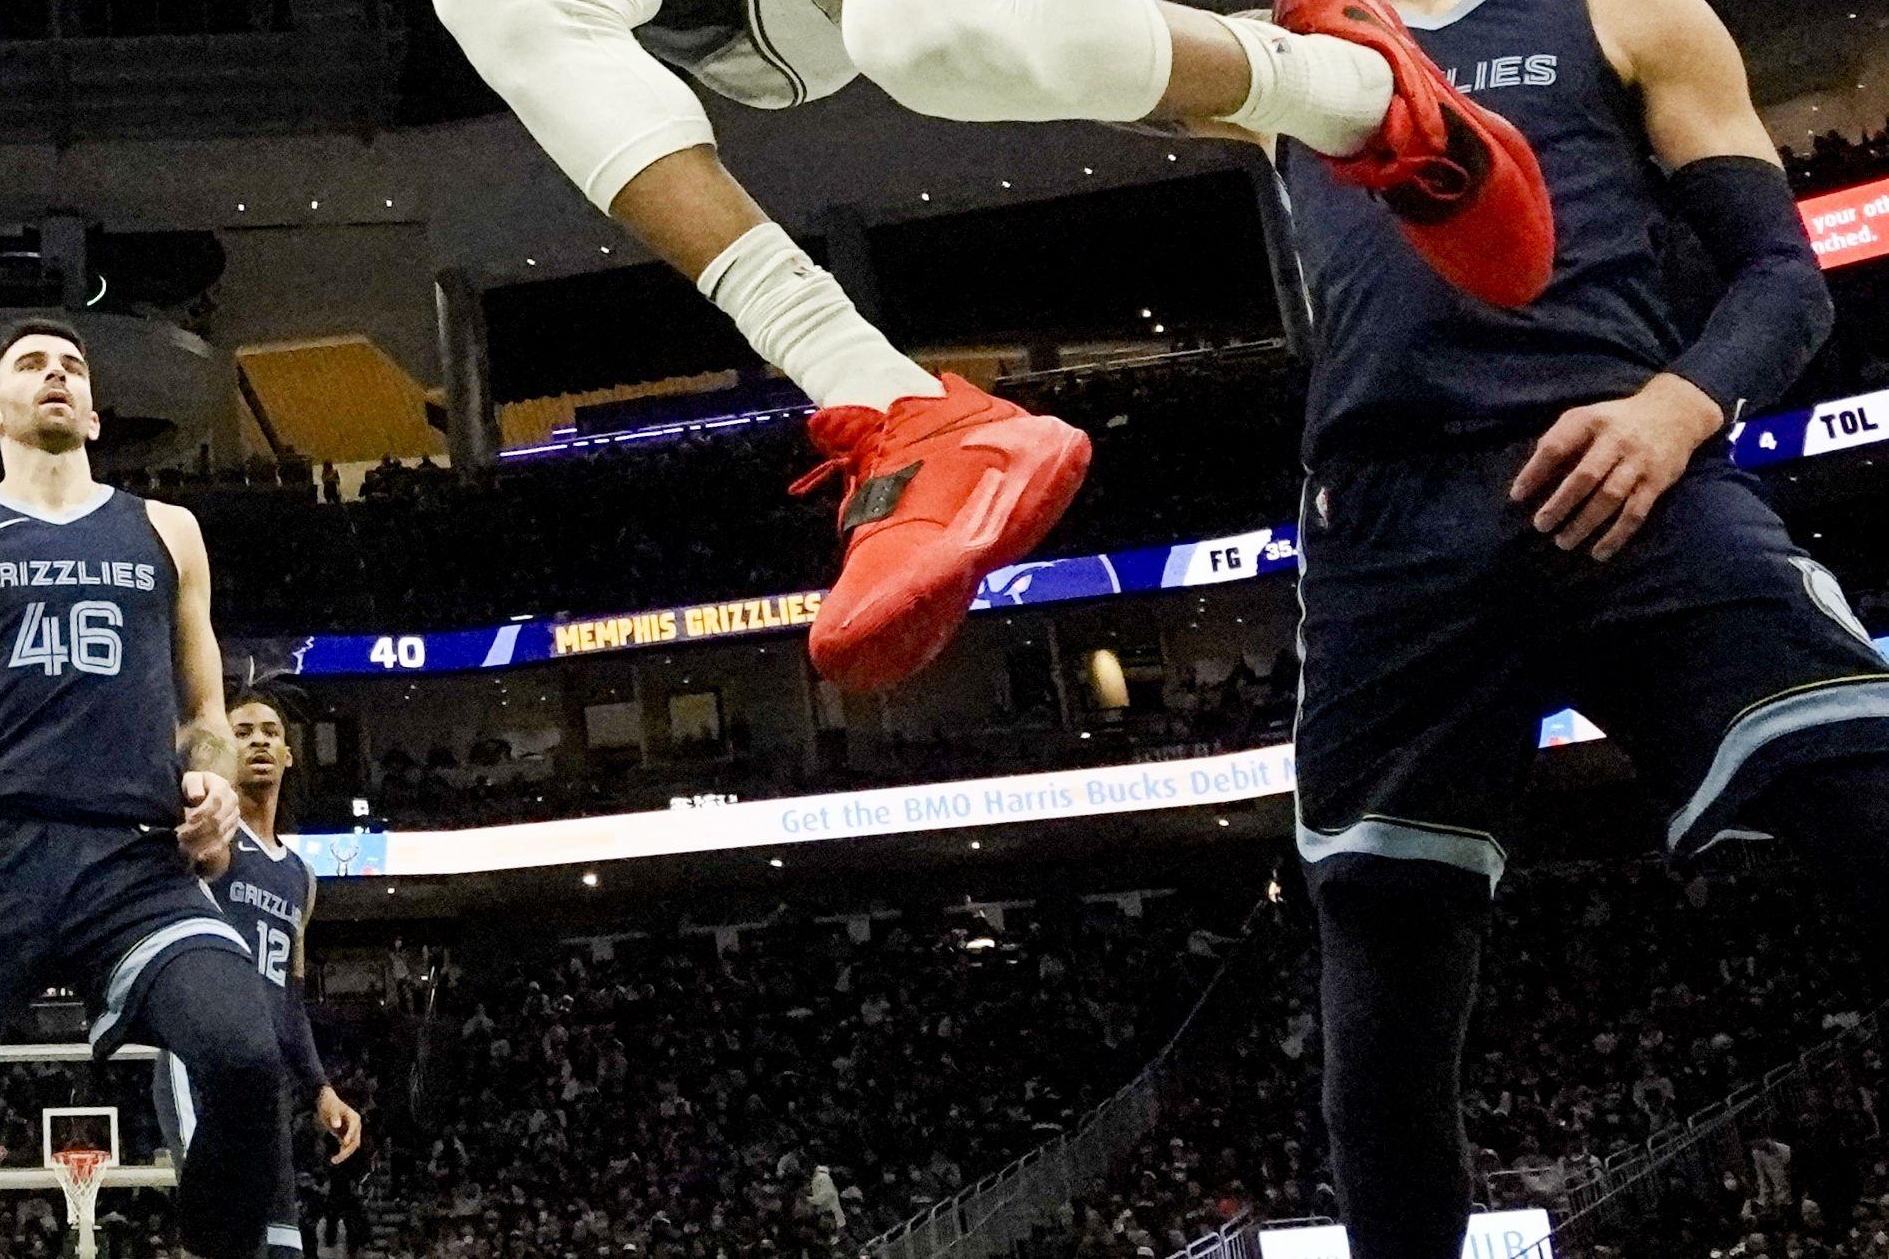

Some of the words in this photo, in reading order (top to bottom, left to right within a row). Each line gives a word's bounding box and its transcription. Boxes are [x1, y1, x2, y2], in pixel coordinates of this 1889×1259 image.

[1812, 207, 1856, 235] your
[1819, 407, 1879, 440] TOL
[1210, 547, 1242, 573] FG
[8, 601, 124, 677] 46
[555, 610, 677, 655] MEMPHIS
[684, 592, 822, 637] GRIZZLIES
[368, 637, 426, 669] 40
[782, 808, 831, 836] Get
[844, 801, 892, 828] the
[904, 793, 972, 822] BMO
[985, 784, 1074, 814] Harris
[1088, 769, 1178, 806] Bucks
[1190, 758, 1271, 796] Debit
[256, 919, 291, 988] 12
